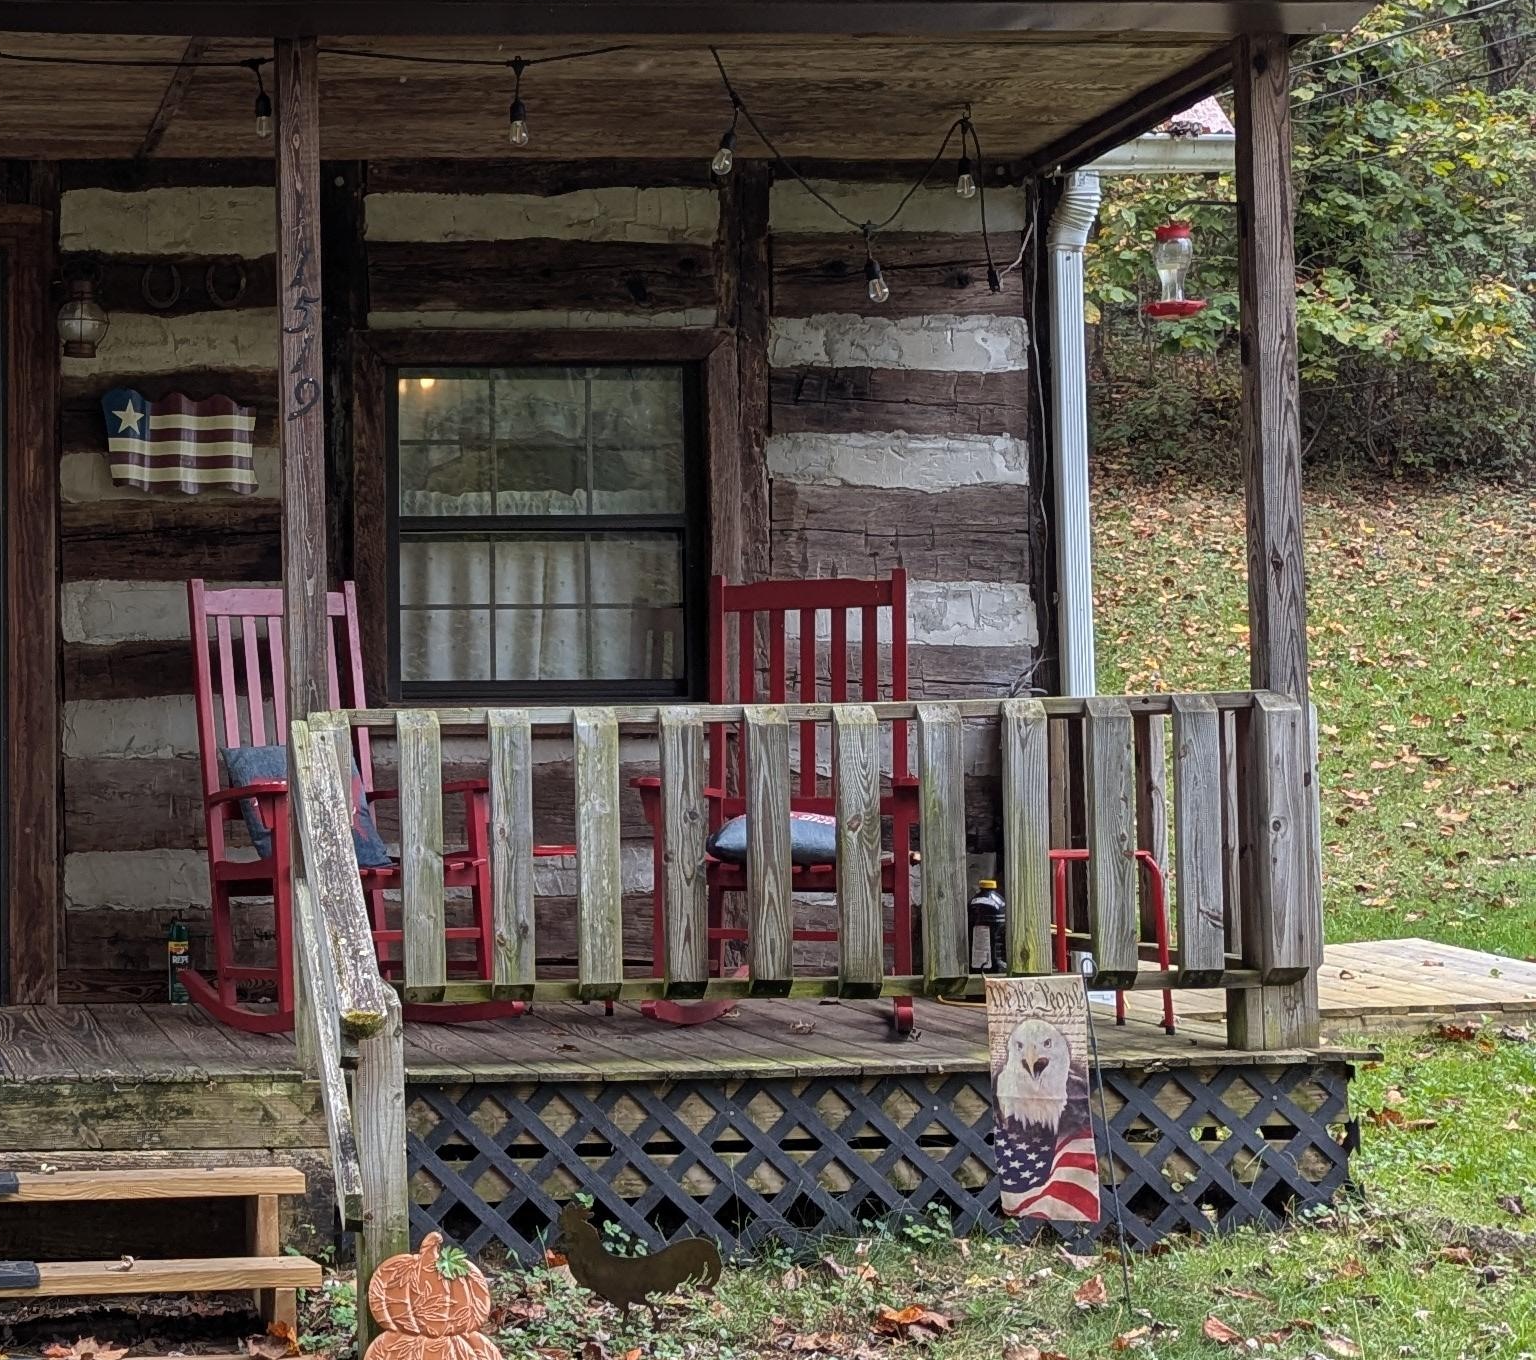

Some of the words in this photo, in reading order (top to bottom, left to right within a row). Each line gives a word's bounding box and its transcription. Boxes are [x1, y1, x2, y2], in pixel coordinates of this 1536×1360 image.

[986, 981, 1012, 1009] We
[1013, 981, 1034, 1012] the
[1034, 980, 1084, 1016] People
